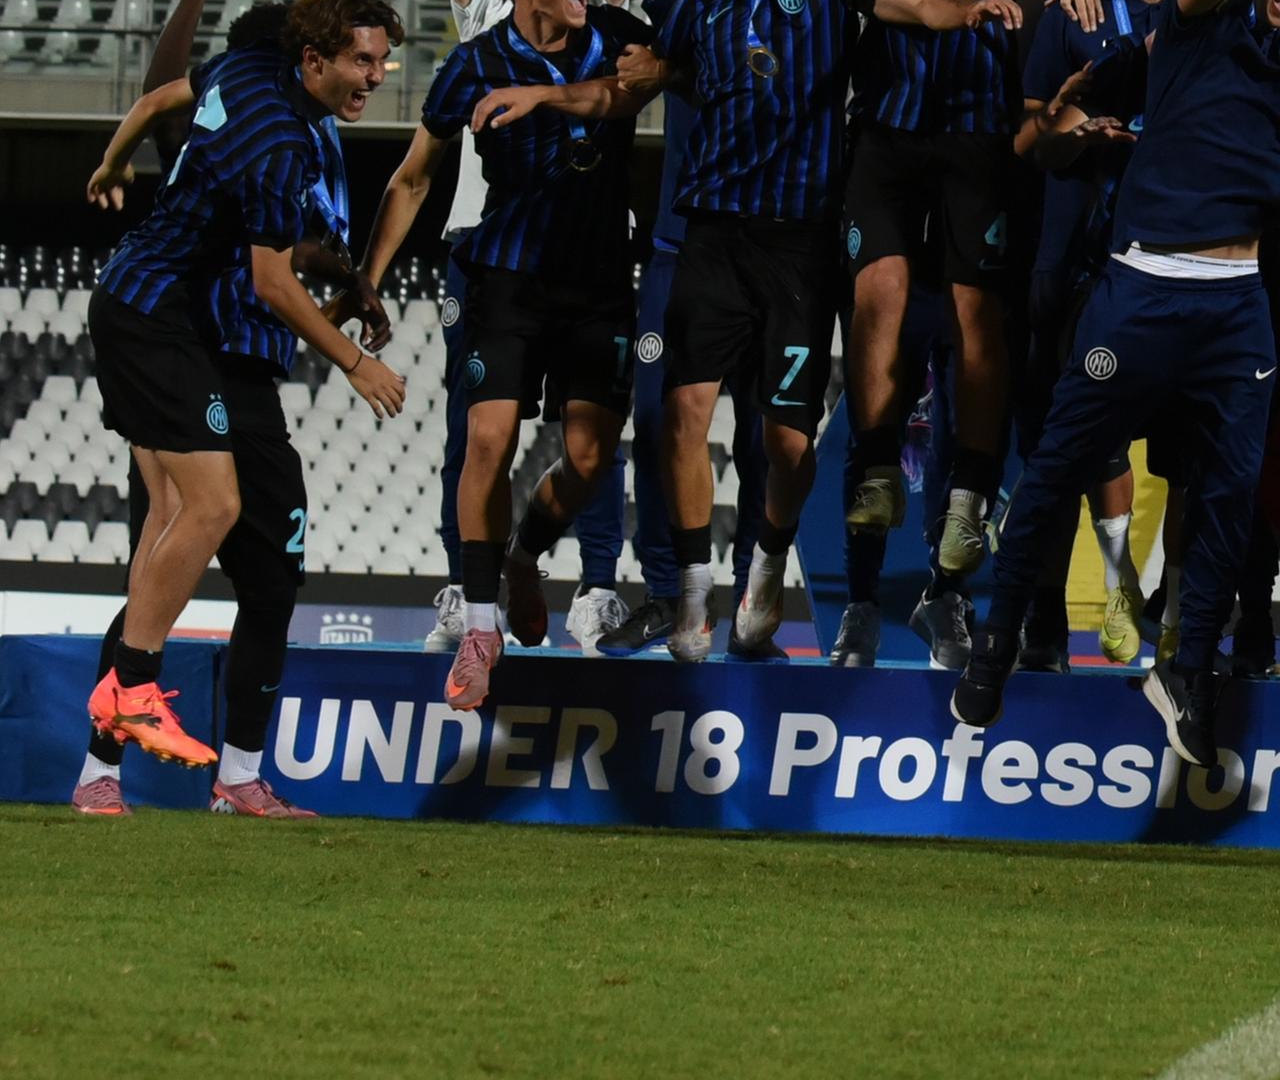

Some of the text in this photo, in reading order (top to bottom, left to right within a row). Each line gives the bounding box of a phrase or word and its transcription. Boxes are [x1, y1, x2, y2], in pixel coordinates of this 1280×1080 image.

[984, 210, 1009, 257] 4
[783, 344, 812, 393] 7
[285, 505, 308, 554] 2
[273, 696, 618, 792] UNDER
[649, 709, 745, 797] 18
